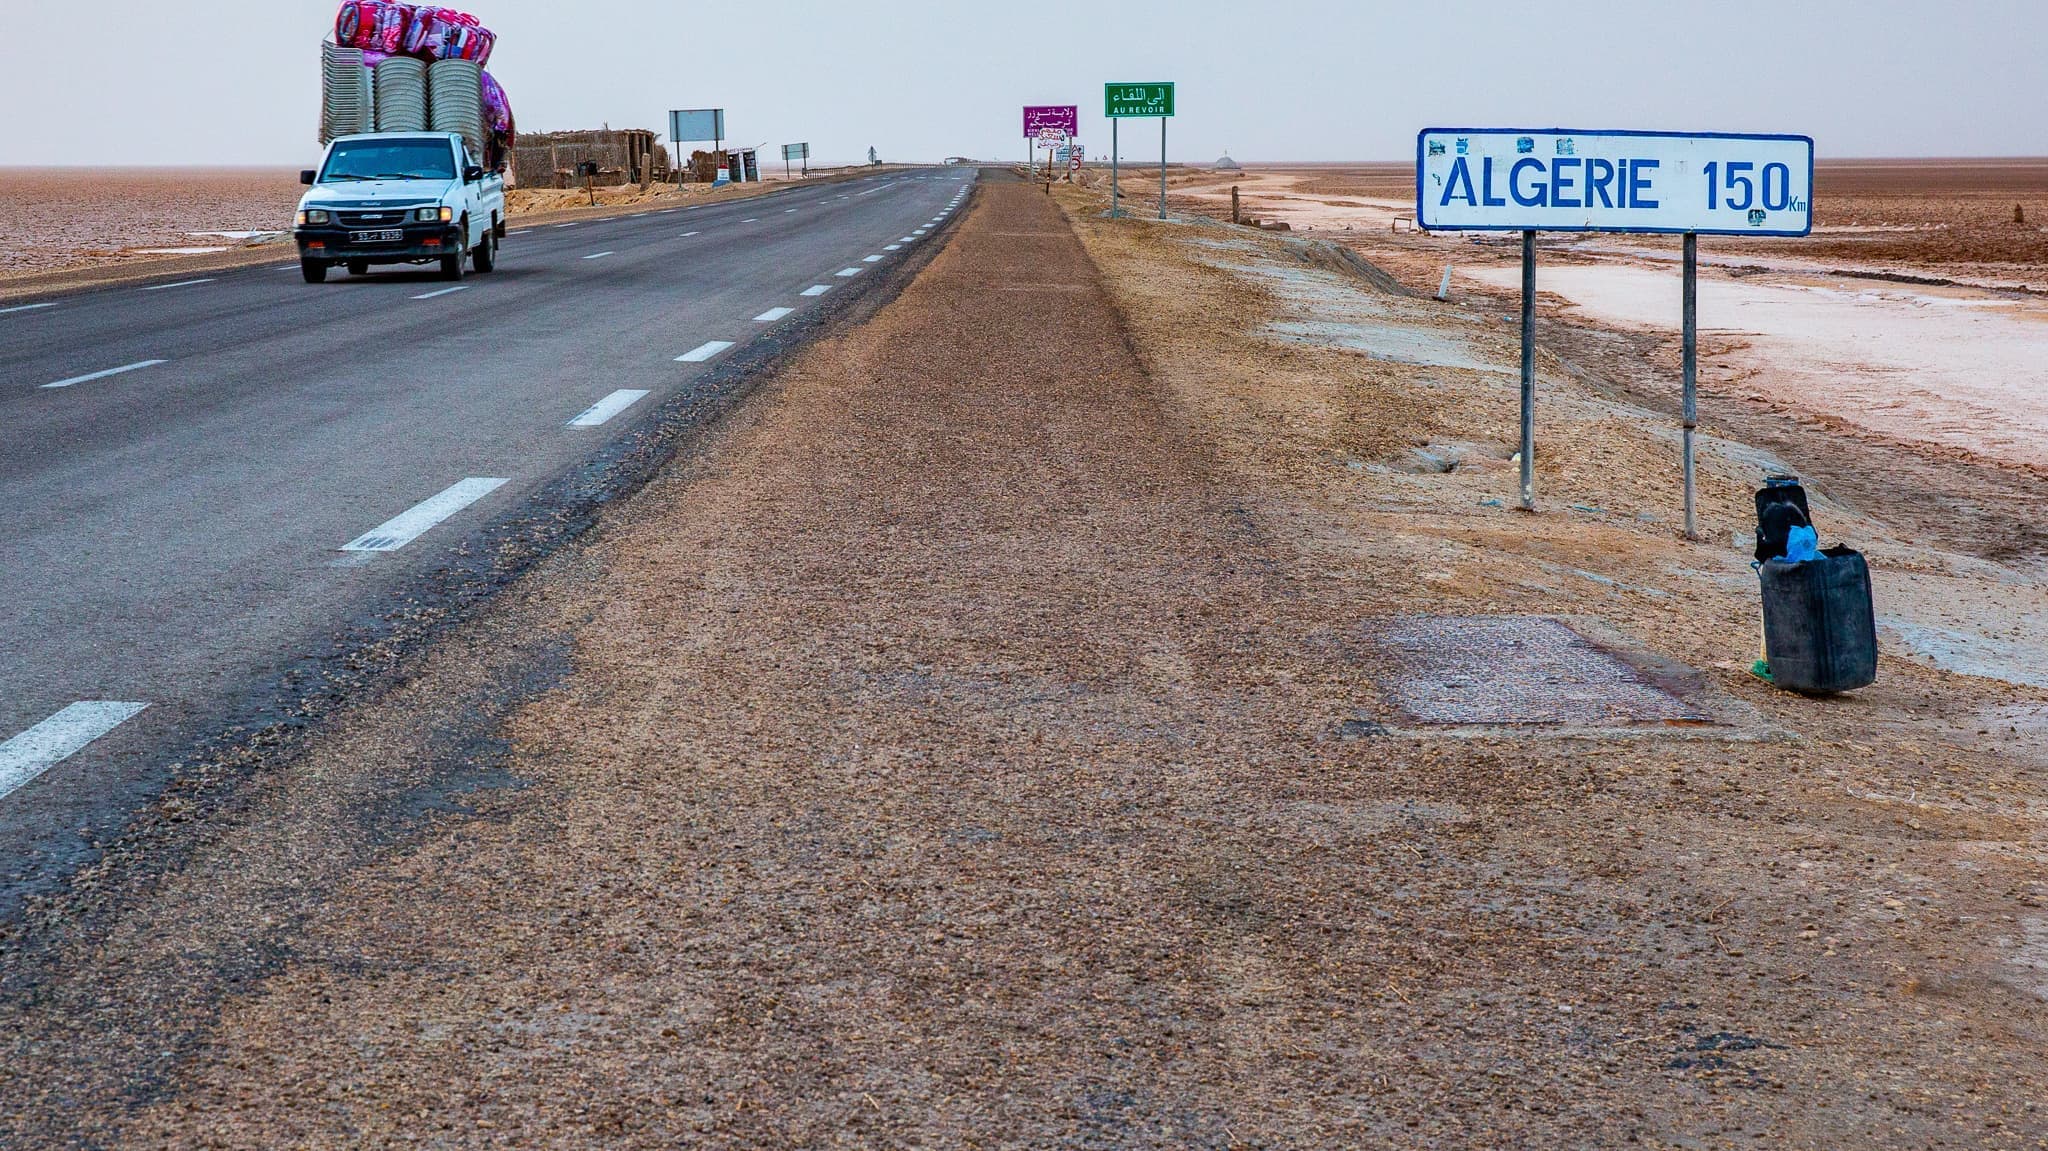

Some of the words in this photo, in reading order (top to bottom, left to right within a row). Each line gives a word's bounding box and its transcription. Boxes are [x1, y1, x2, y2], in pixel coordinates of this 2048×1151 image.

[1113, 87, 1146, 102] اللقاء
[1147, 87, 1165, 105] إلى
[1028, 109, 1051, 119] توزر
[1052, 107, 1073, 117] ولاية
[1129, 106, 1165, 114] REVOIR
[1703, 161, 1790, 211] 150
